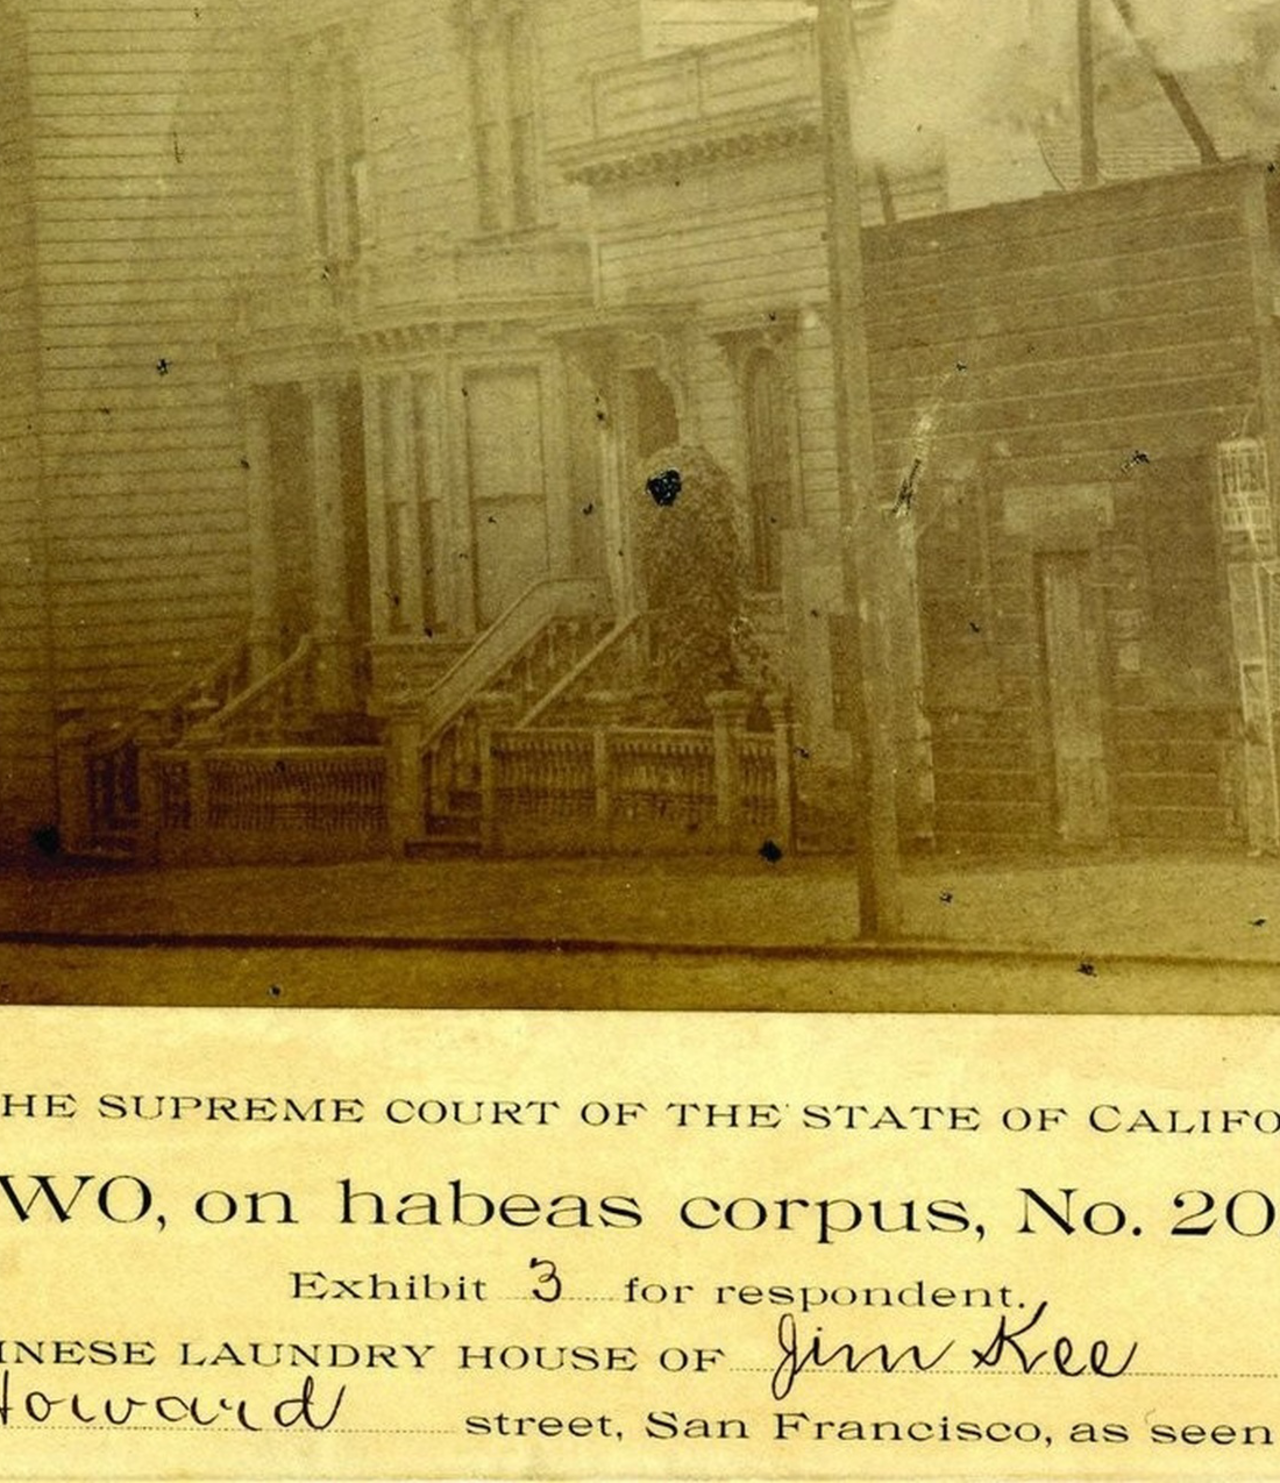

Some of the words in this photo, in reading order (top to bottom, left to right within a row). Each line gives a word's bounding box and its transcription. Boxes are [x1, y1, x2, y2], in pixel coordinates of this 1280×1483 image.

[98, 1094, 364, 1123] SUPREME
[386, 1099, 560, 1125] COURT
[581, 1102, 647, 1126] OF
[666, 1103, 781, 1129] THE
[803, 1105, 980, 1131] STATE
[1002, 1107, 1068, 1131] OF
[195, 1190, 299, 1224] on
[337, 1178, 642, 1228] habeas
[680, 1197, 985, 1244] corpus,
[1017, 1188, 1142, 1236] No.
[289, 1271, 487, 1301] Exhibit
[529, 1257, 562, 1303] 3
[625, 1277, 694, 1303] for
[717, 1280, 1024, 1313] respondent.
[180, 1342, 435, 1368] LAUNDRY
[458, 1346, 637, 1371] HOUSE
[660, 1348, 725, 1372] OF
[771, 1312, 955, 1401] Jim
[466, 1413, 622, 1441] street,
[645, 1411, 749, 1439] San
[773, 1412, 1052, 1448] Francisco,
[1070, 1423, 1129, 1443] as
[1151, 1424, 1273, 1445] seen
